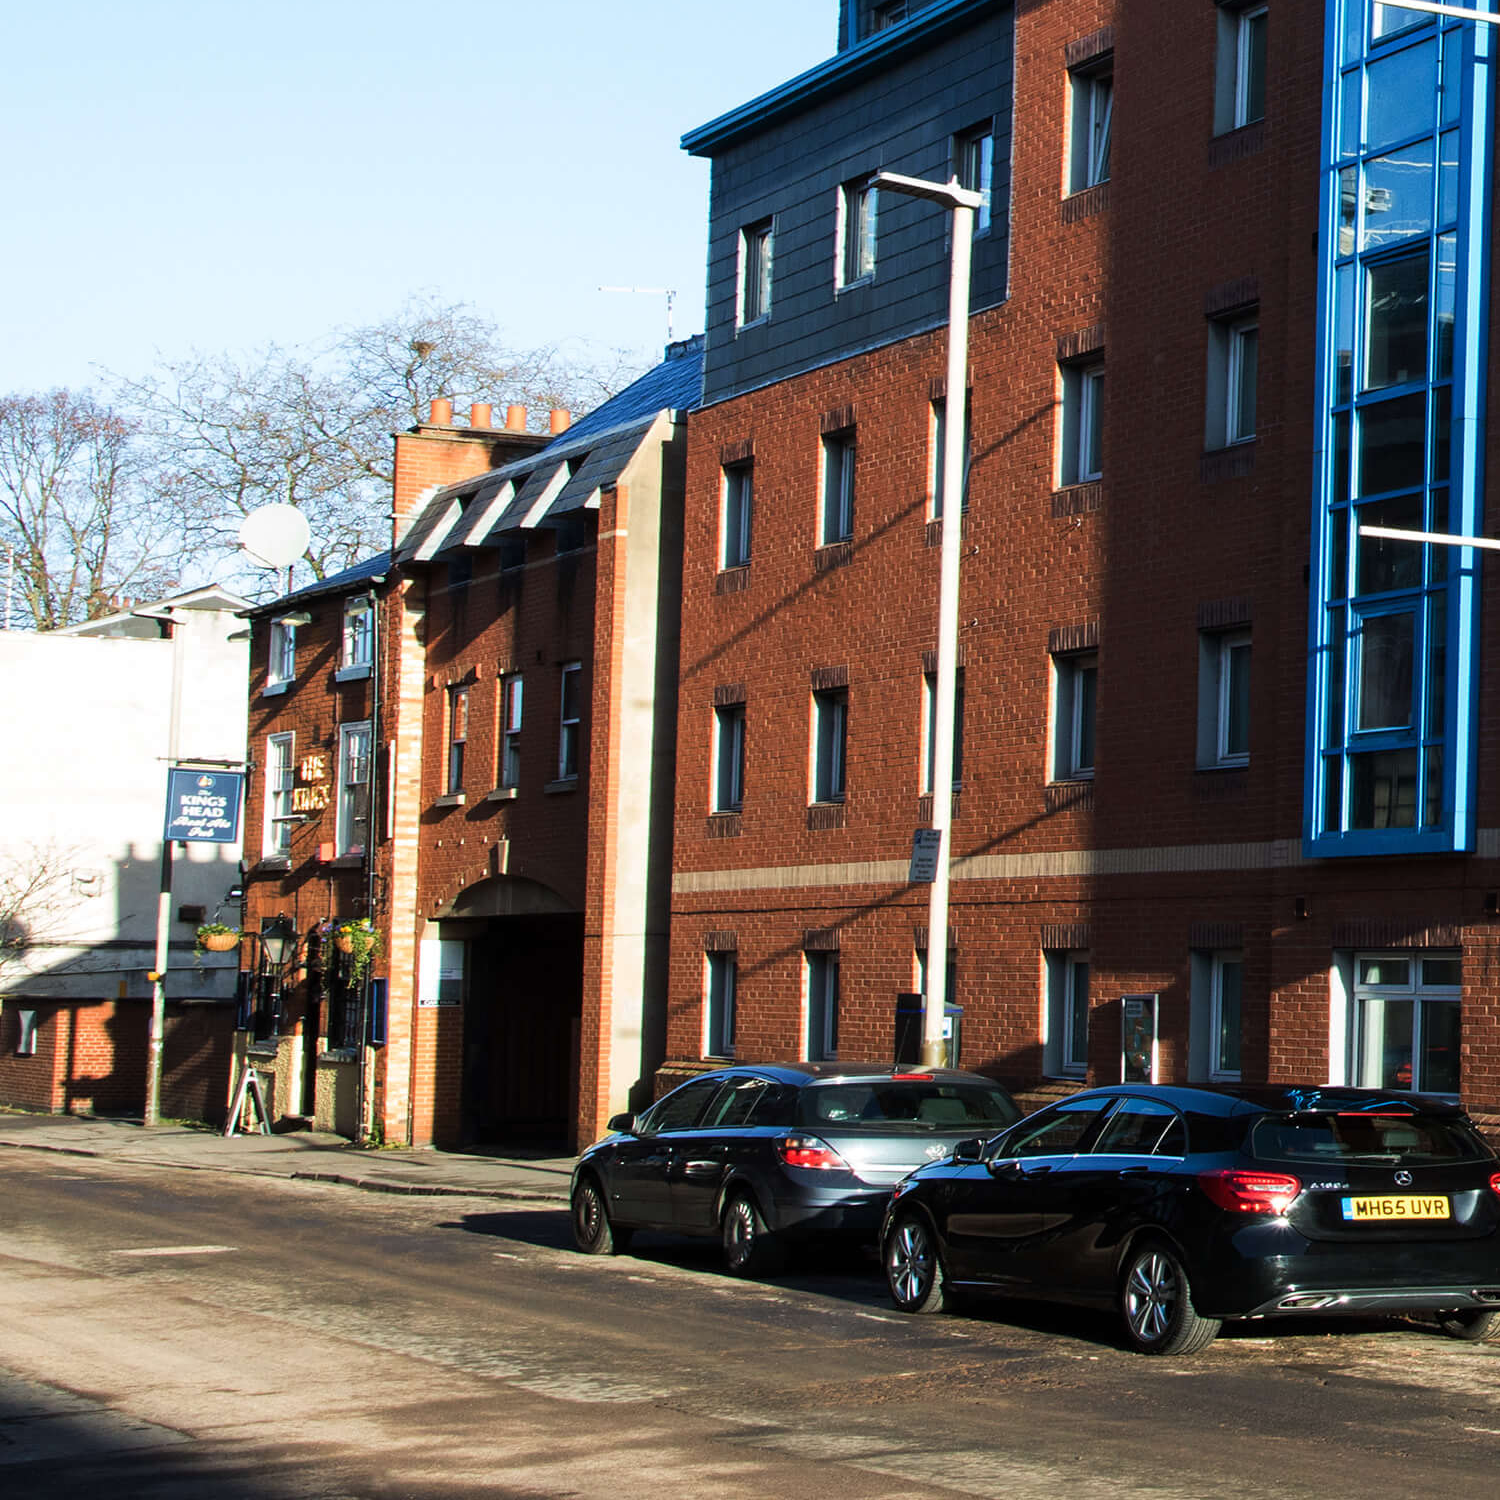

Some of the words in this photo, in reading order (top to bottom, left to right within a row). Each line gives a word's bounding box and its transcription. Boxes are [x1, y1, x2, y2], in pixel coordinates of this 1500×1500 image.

[182, 805, 225, 818] HEAD
[1355, 1200, 1406, 1216] MH65
[1411, 1200, 1445, 1216] UVR
